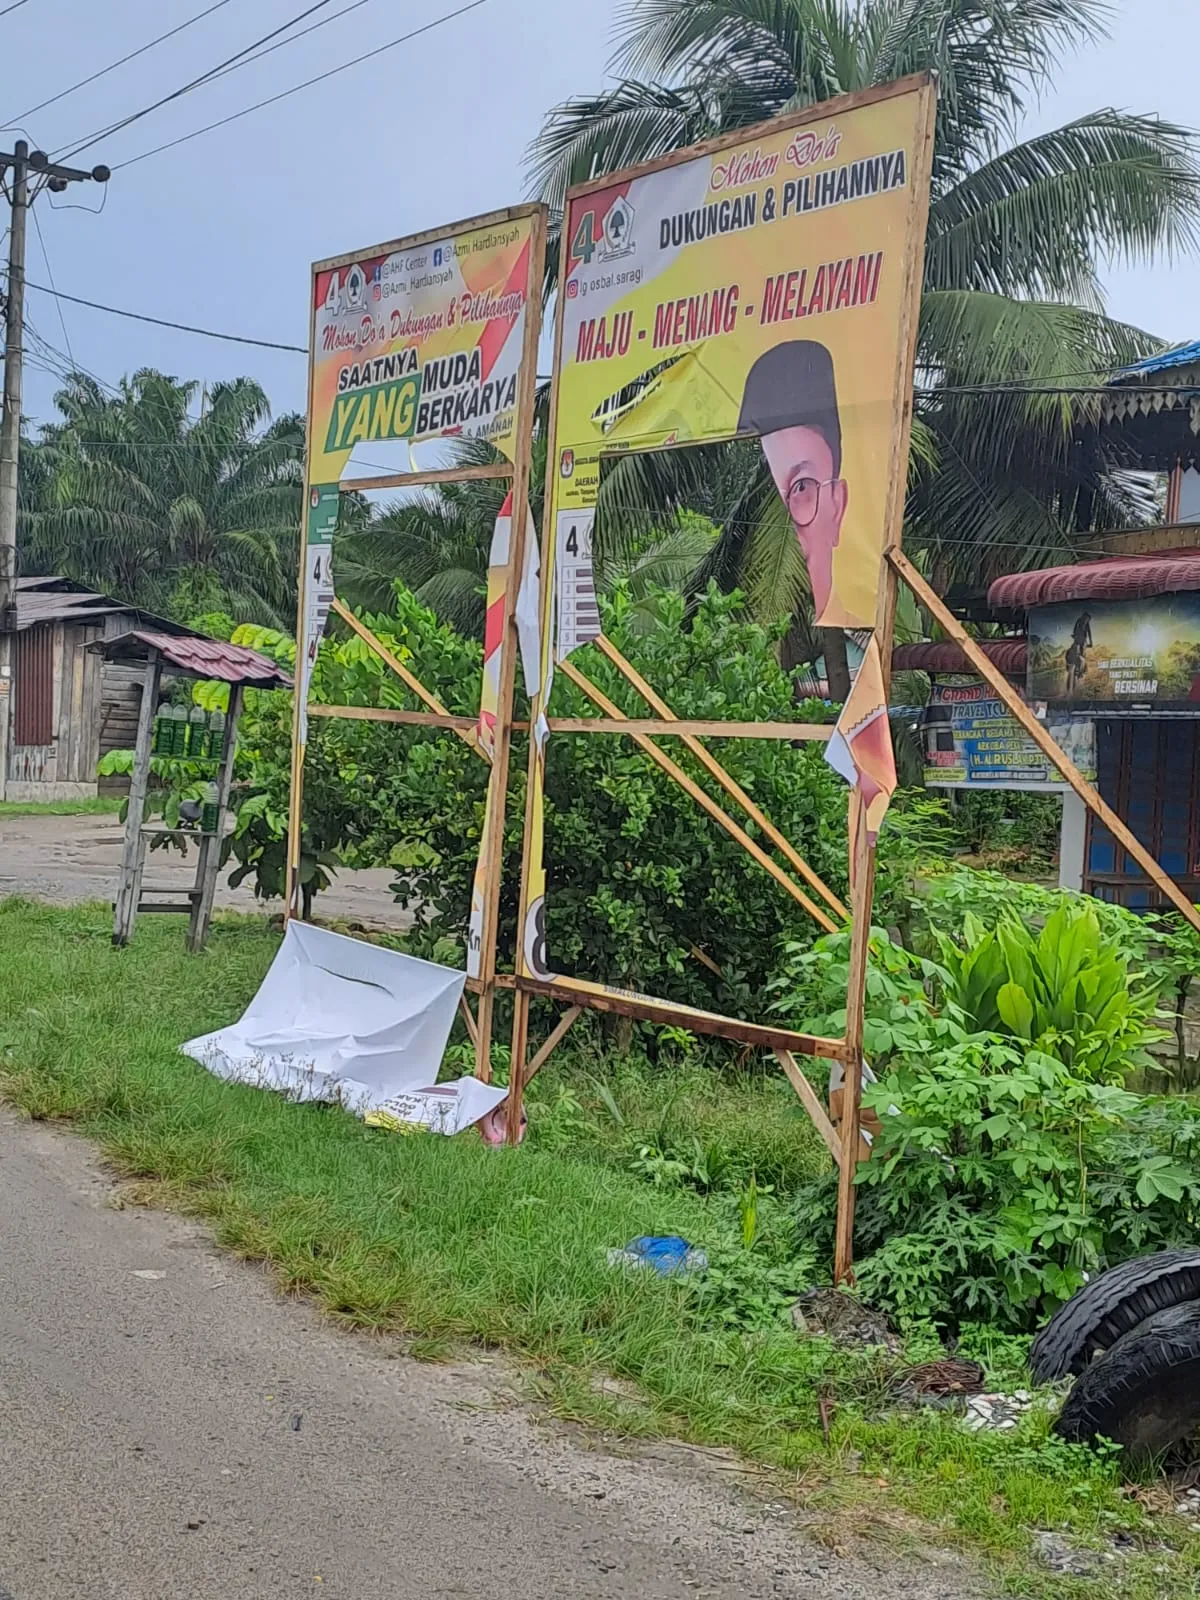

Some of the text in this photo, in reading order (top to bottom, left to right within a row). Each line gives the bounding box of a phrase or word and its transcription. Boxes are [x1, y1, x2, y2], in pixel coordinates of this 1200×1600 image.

[710, 149, 779, 191] Mohon
[659, 150, 906, 250] DUKUNGAN & PILIHANNYA
[573, 211, 596, 265] 4
[325, 271, 342, 317] 4
[447, 297, 457, 326] &
[575, 311, 634, 363] MAJU
[652, 285, 740, 348] MENANG
[760, 251, 883, 325] MELAYANI
[338, 349, 418, 392] SAATNYA
[421, 350, 481, 395] MUDA
[334, 381, 416, 448] YANG
[416, 374, 517, 434] BERKARYA
[566, 525, 579, 557] 4
[313, 555, 321, 584] 4
[1114, 680, 1158, 694] BERSINAR
